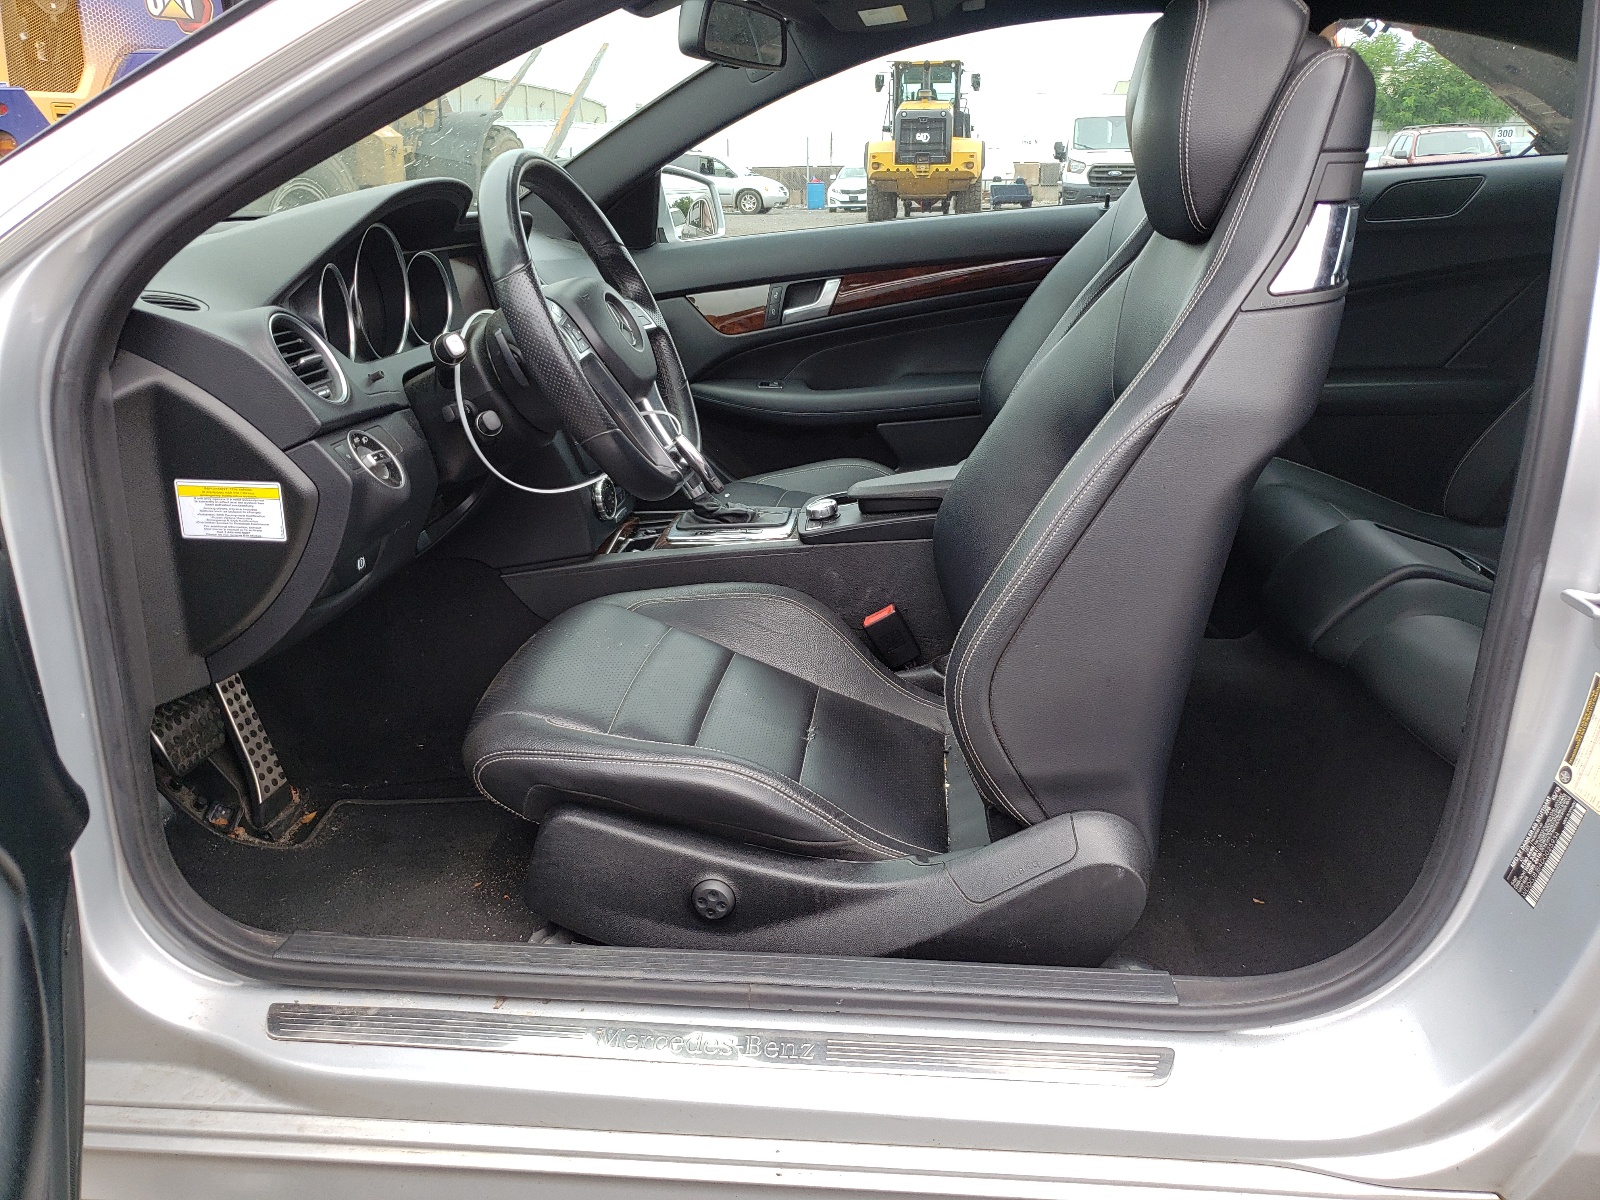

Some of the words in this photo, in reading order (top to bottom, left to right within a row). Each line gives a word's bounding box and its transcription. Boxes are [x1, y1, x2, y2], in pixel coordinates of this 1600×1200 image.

[1497, 129, 1514, 138] 300
[1260, 298, 1297, 308] AIRBAG
[596, 1027, 816, 1059] Mercedes-Benz
